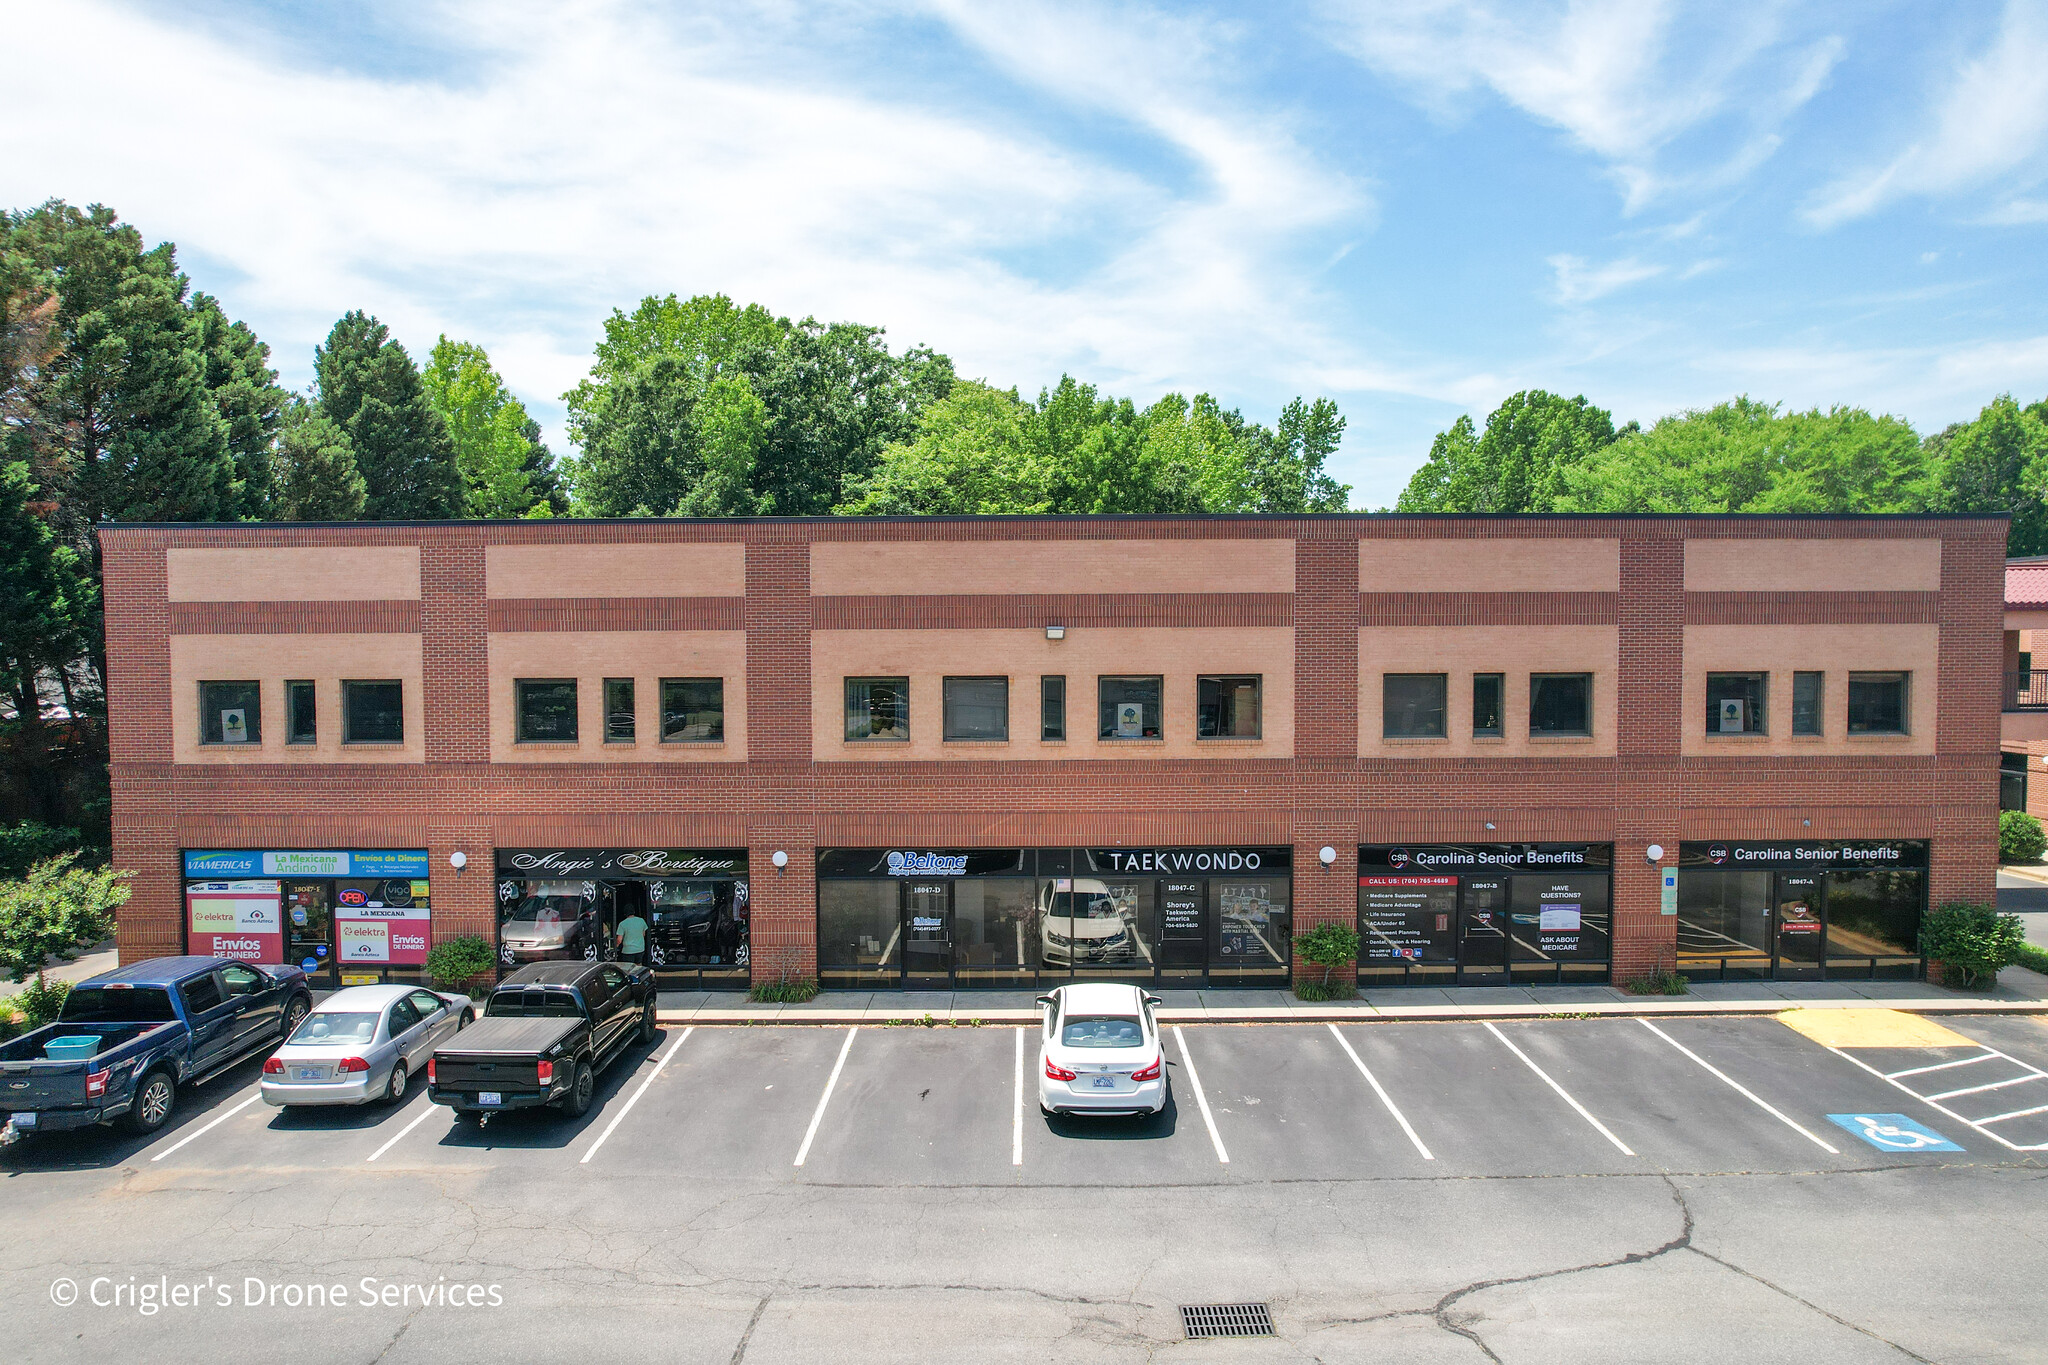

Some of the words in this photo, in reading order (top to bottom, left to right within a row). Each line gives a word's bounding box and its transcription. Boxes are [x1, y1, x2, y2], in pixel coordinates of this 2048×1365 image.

[275, 854, 288, 863] La
[290, 854, 338, 863] Mexicana
[384, 854, 396, 862] de
[398, 854, 427, 862] Dinero
[1391, 854, 1408, 862] CSB
[1416, 853, 1475, 865] Carolina
[1477, 852, 1524, 865] Senior
[1527, 851, 1584, 864] Benefits
[1734, 848, 1791, 860] Carolina
[1794, 847, 1840, 860] Senior
[1842, 847, 1900, 860] Benefits
[187, 860, 253, 870] VIAMERICAS
[511, 851, 612, 875] Angie's
[616, 850, 734, 875] Boutique
[903, 852, 966, 868] Beltone
[275, 863, 318, 873] Andino
[388, 885, 410, 895] vigo
[341, 892, 364, 902] OPEN
[204, 913, 234, 921] elektra
[353, 928, 386, 936] elektra
[213, 936, 261, 950] Envíos
[393, 934, 424, 944] Envíos
[214, 951, 226, 959] DE
[227, 951, 261, 959] DINERO
